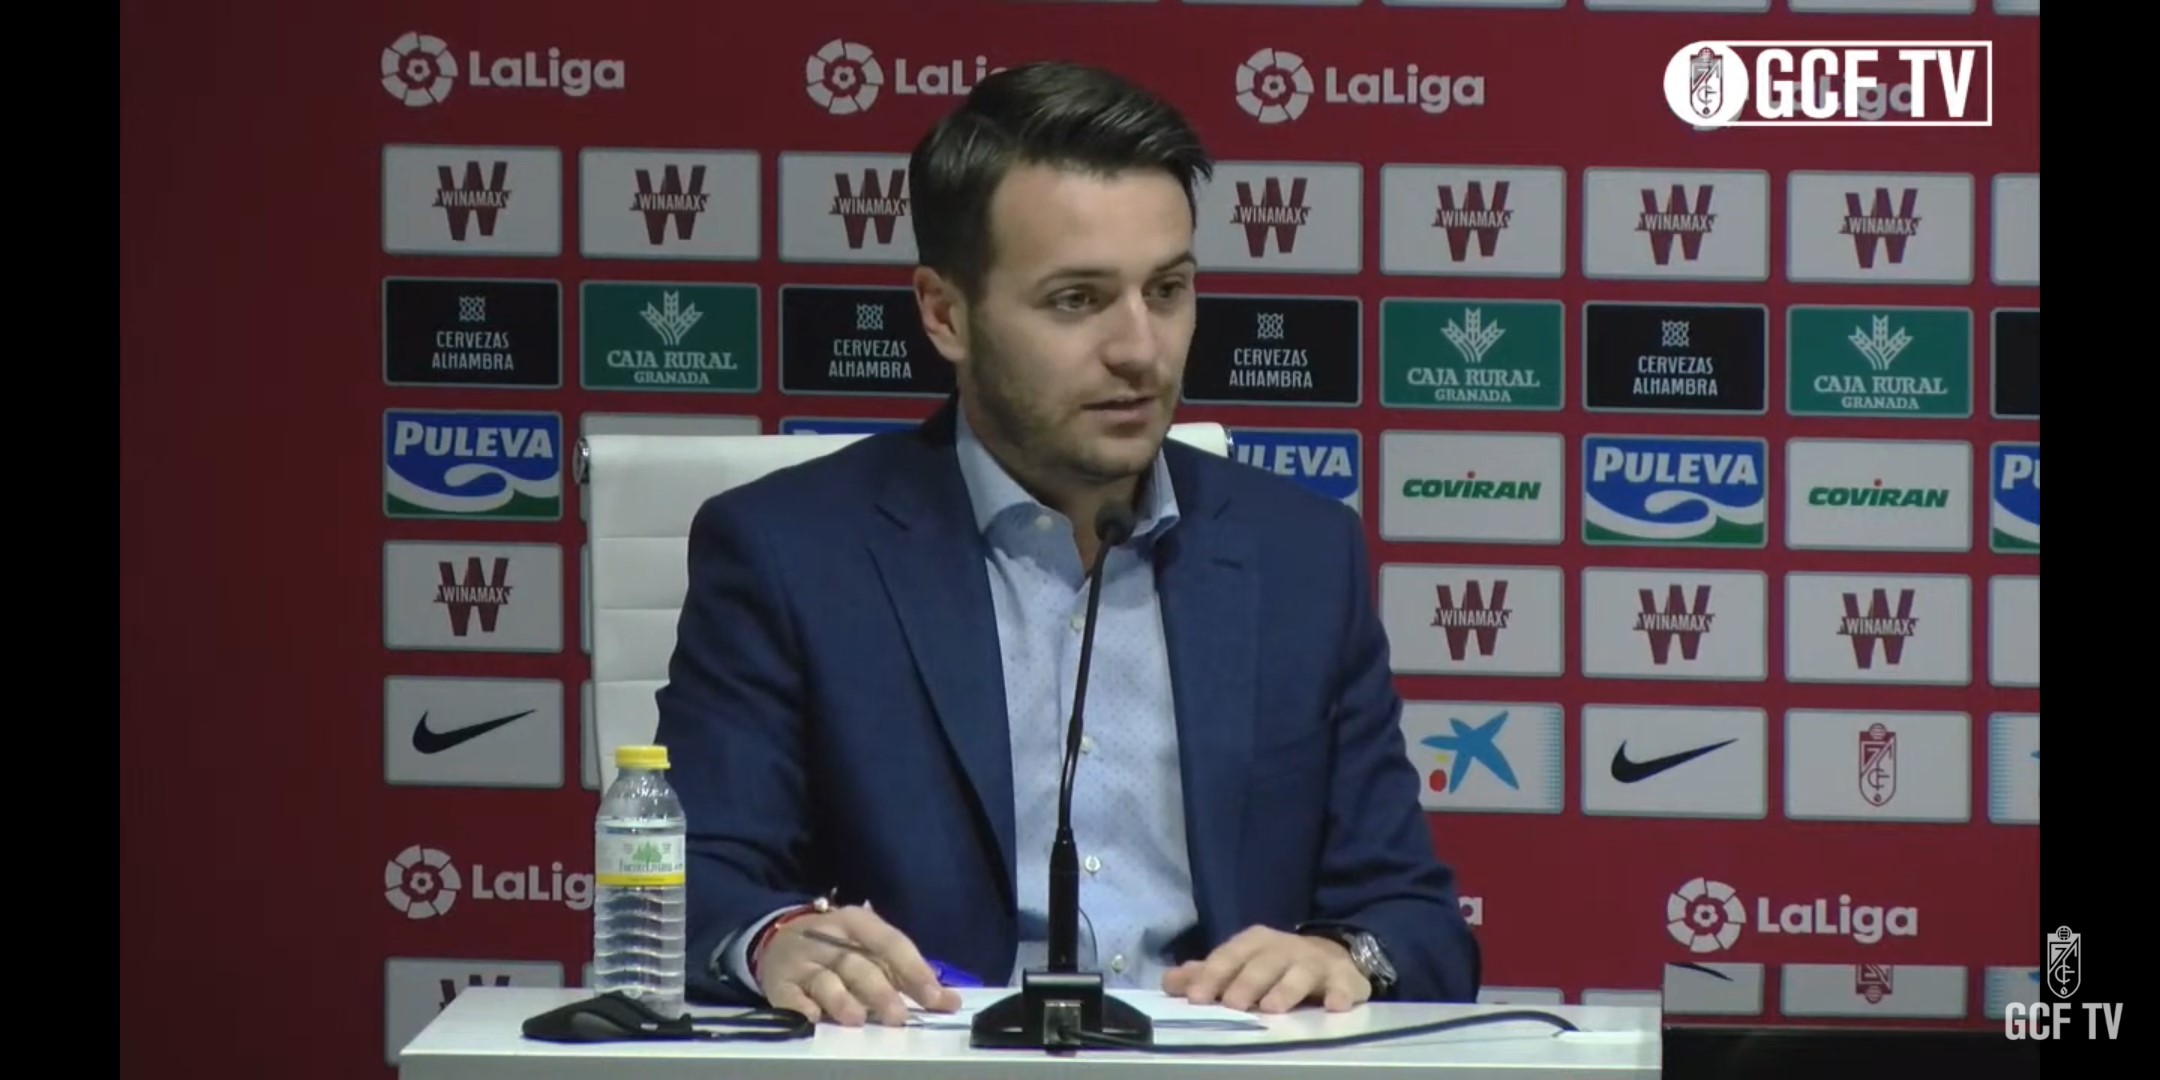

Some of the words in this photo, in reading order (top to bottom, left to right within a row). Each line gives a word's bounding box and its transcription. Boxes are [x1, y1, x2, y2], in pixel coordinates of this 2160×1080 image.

[470, 47, 624, 96] LaLiga
[896, 56, 1006, 95] LaLi
[1326, 64, 1484, 113] LaLiga
[442, 189, 504, 207] WINAMAX
[639, 193, 701, 211] WINAMAX
[839, 197, 901, 215] WINAMAX
[1240, 206, 1302, 224] WINAMAX
[1442, 209, 1504, 227] WINAMAX
[1645, 213, 1707, 231] WINAMAX
[1849, 216, 1911, 234] WINAMAX
[437, 331, 509, 348] CERVEZAS
[834, 339, 907, 357] CERVEZAS
[432, 353, 513, 369] ALHAMBRA
[607, 350, 658, 368] CAJA
[664, 352, 737, 369] RURAL
[1234, 349, 1307, 366] CERVEZAS
[1639, 356, 1713, 374] CERVEZAS
[634, 371, 709, 384] GRANADA
[829, 361, 911, 378] ALHAMBRA
[1230, 370, 1312, 387] ALHAMBRA
[1408, 368, 1459, 386] CAJA
[1465, 369, 1540, 388] RURAL
[1633, 378, 1717, 395] ALHAMBRA
[1814, 376, 1866, 393] CAJA
[1872, 376, 1947, 394] RURAL
[1435, 389, 1511, 402] GRANADA
[1842, 396, 1919, 409] GRANADA
[394, 421, 553, 458] PULEVA
[1237, 444, 1353, 477] LEVA
[1594, 447, 1757, 484] PULEVA
[442, 585, 504, 603] WINAMAX
[1440, 608, 1502, 626] WINAMAX
[1643, 613, 1705, 631] WINAMAX
[1846, 617, 1908, 635] WINAMAX
[473, 862, 594, 911] LaLig
[1758, 894, 1917, 943] LaLiga
